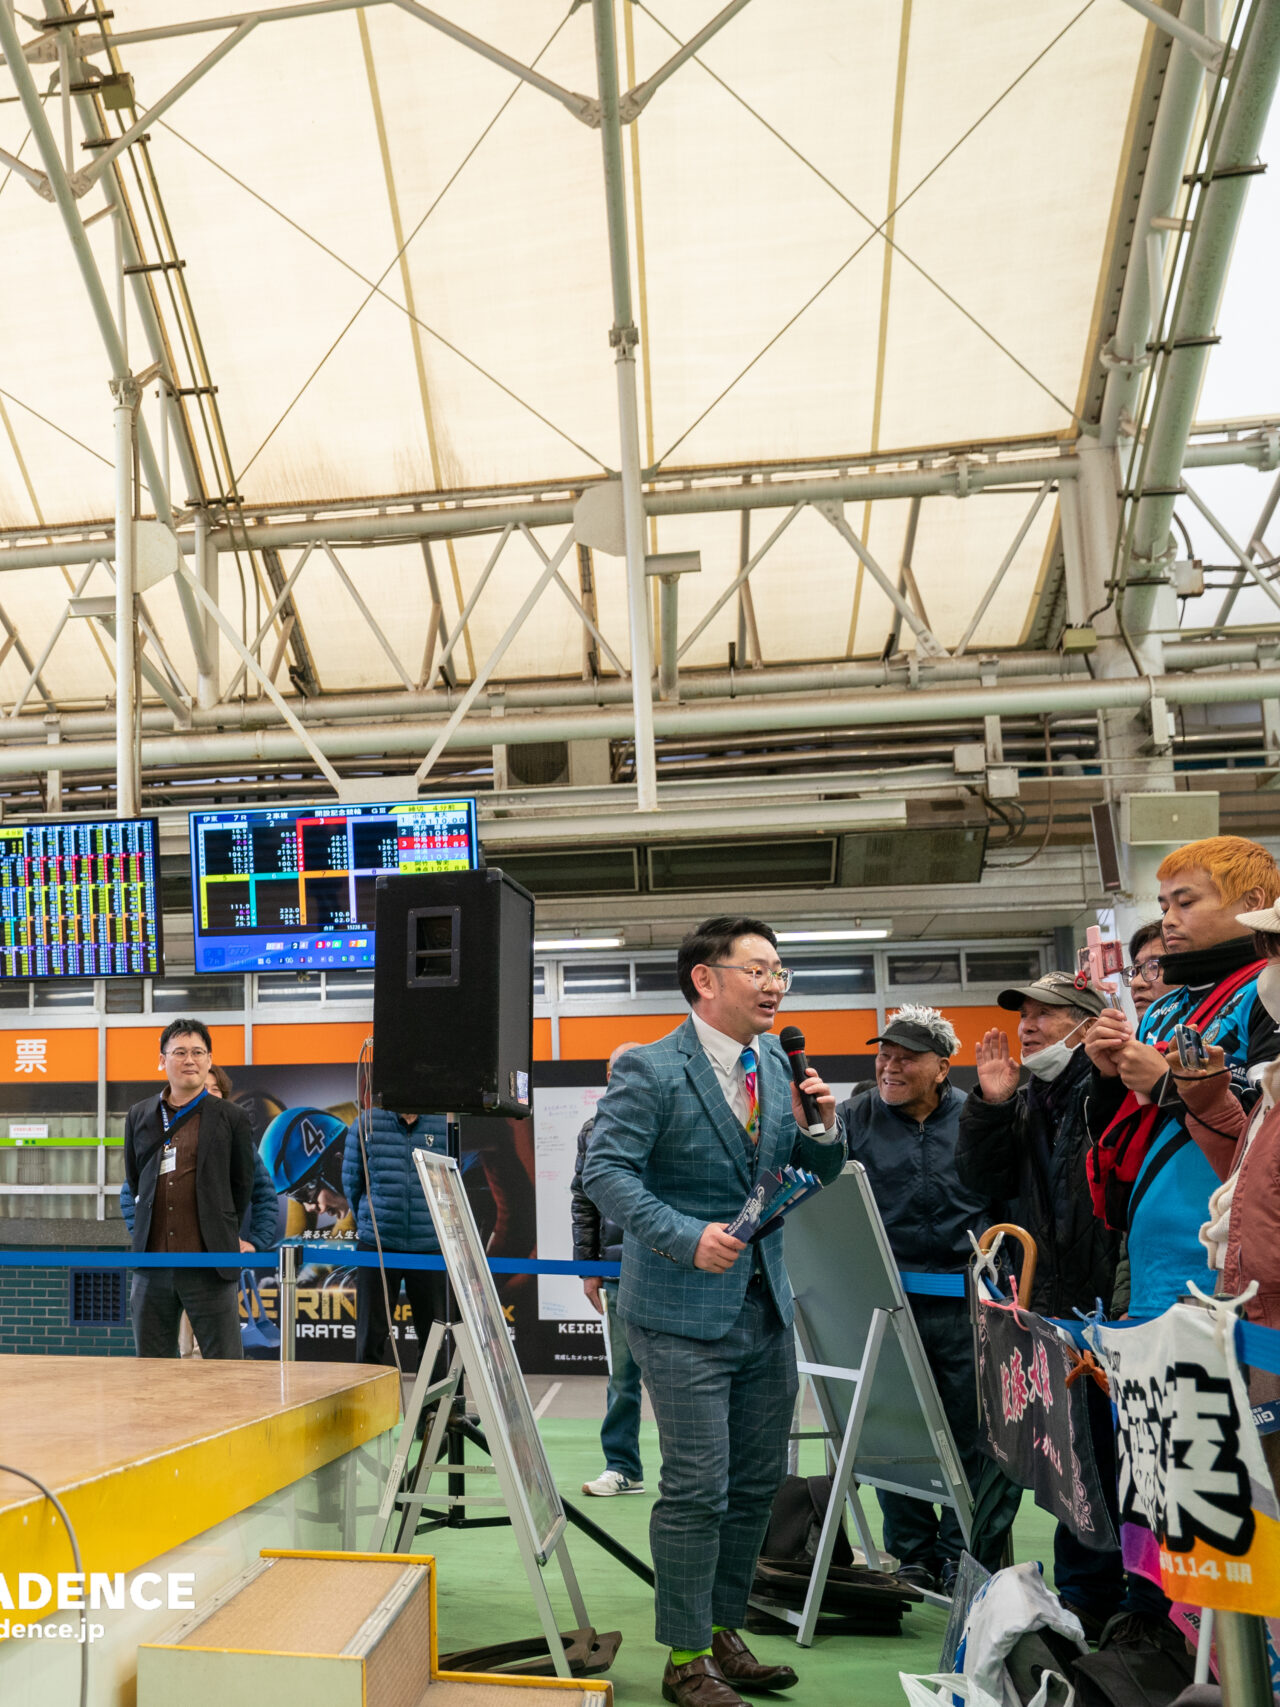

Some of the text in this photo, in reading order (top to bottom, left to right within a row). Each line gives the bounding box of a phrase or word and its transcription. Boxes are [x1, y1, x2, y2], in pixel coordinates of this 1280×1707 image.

[14, 1038, 48, 1074] 票
[301, 1118, 326, 1157] 4
[238, 1289, 357, 1320] ERIN
[558, 1323, 603, 1334] KEIRI
